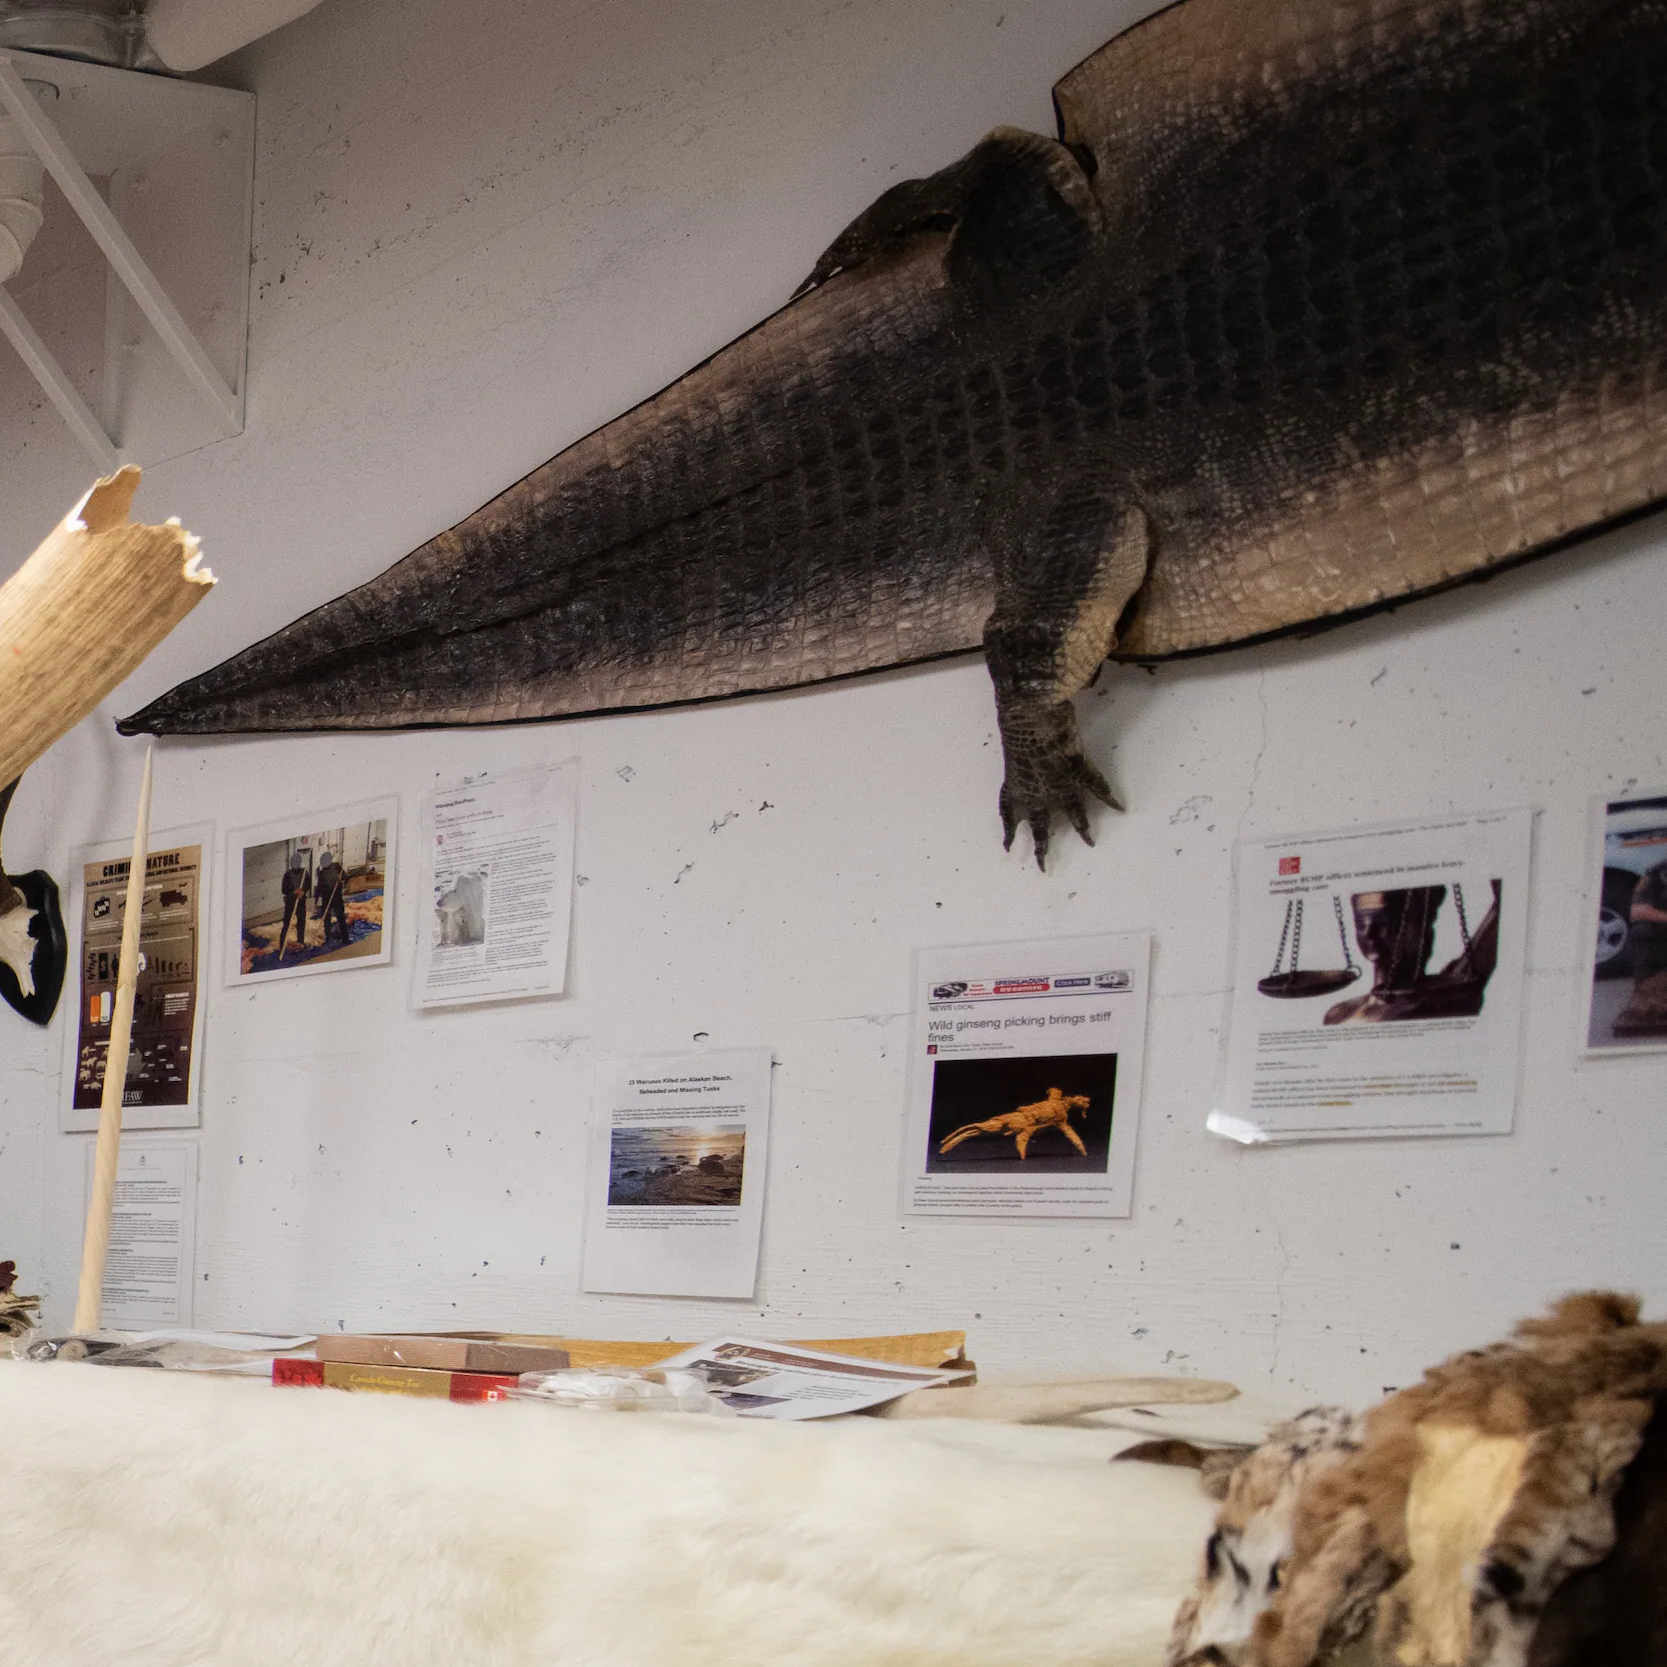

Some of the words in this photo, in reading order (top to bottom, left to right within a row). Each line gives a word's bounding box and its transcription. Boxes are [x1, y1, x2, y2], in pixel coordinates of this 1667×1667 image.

[146, 852, 180, 869] NATURE
[995, 977, 1049, 986] SPRINGMOUNT
[929, 1021, 953, 1031] Wild
[956, 1018, 1001, 1032] ginseng
[1004, 1015, 1045, 1029] picking
[1049, 1012, 1086, 1026] brings
[1089, 1011, 1112, 1023] stiff
[928, 1033, 954, 1043] fines
